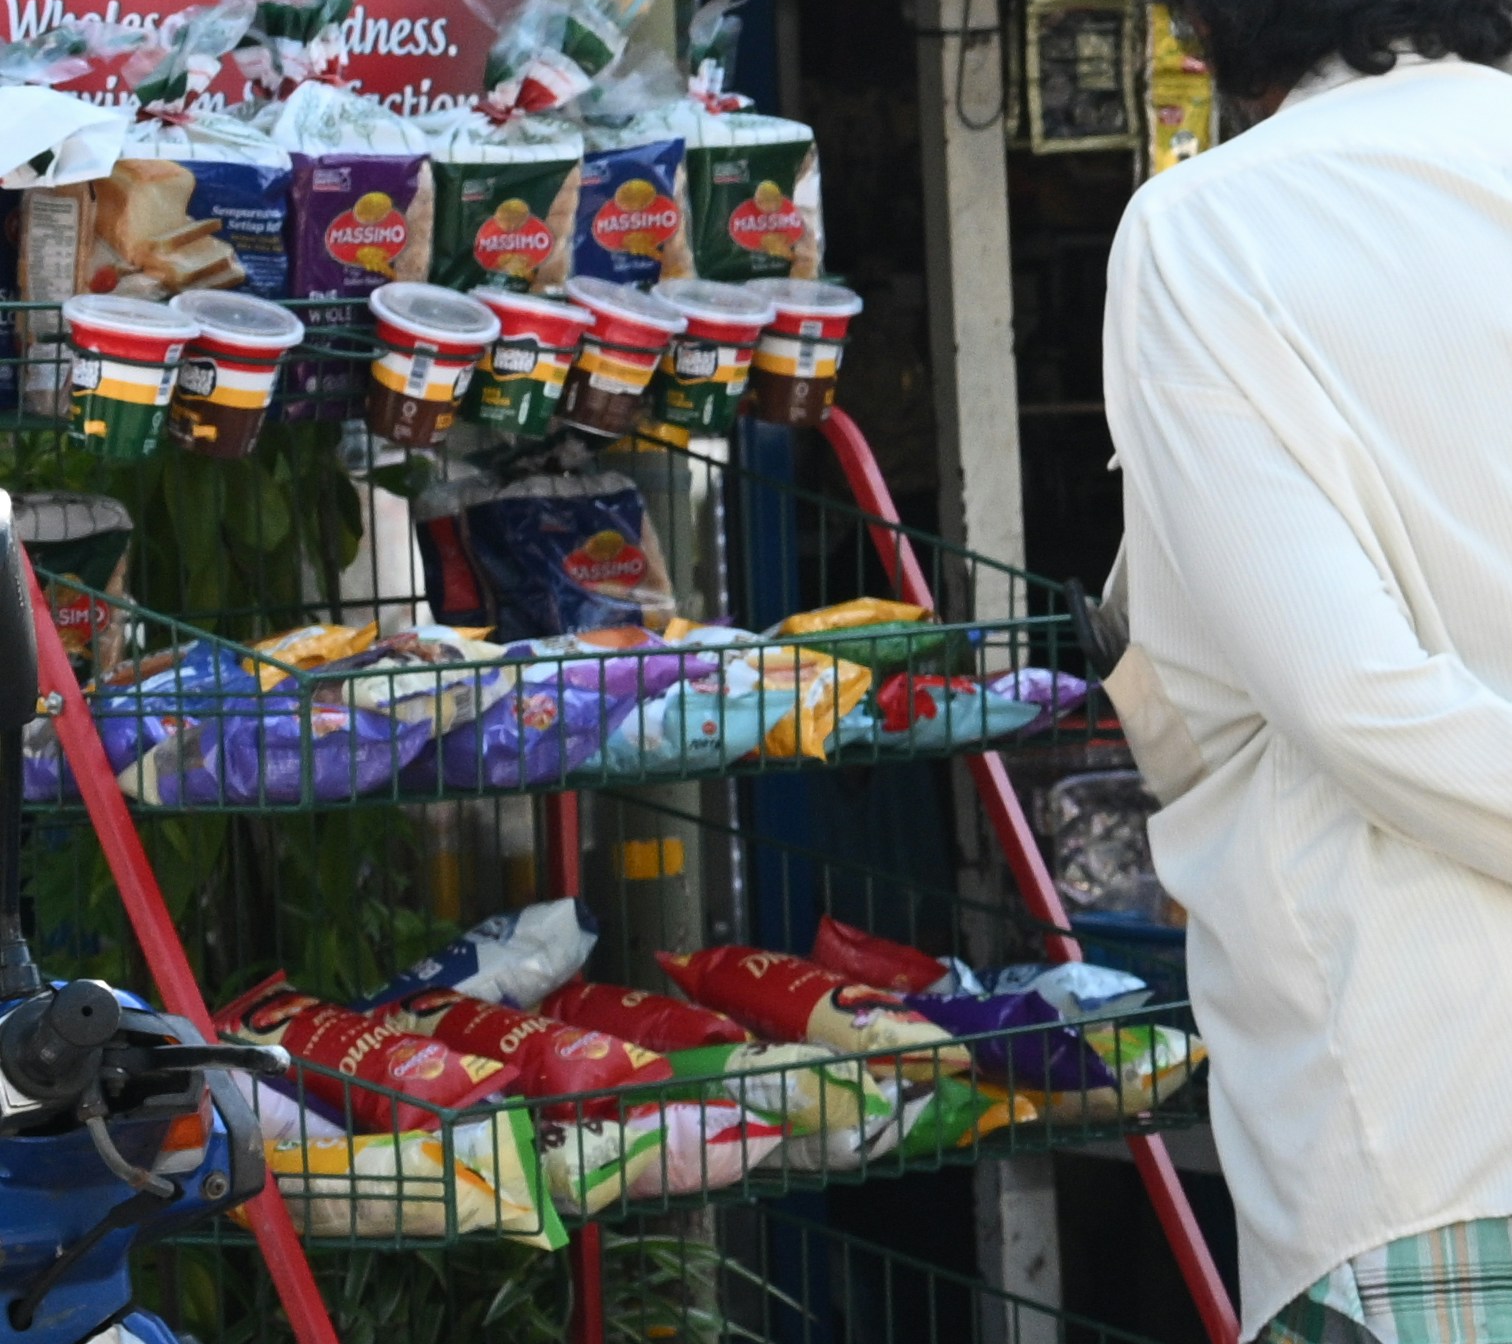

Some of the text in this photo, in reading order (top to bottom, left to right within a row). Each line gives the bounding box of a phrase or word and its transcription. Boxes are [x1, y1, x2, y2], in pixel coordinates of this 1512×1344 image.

[597, 210, 677, 233] MASSIMO
[330, 225, 405, 245] MASSIMO
[480, 232, 549, 253] MASSIMO
